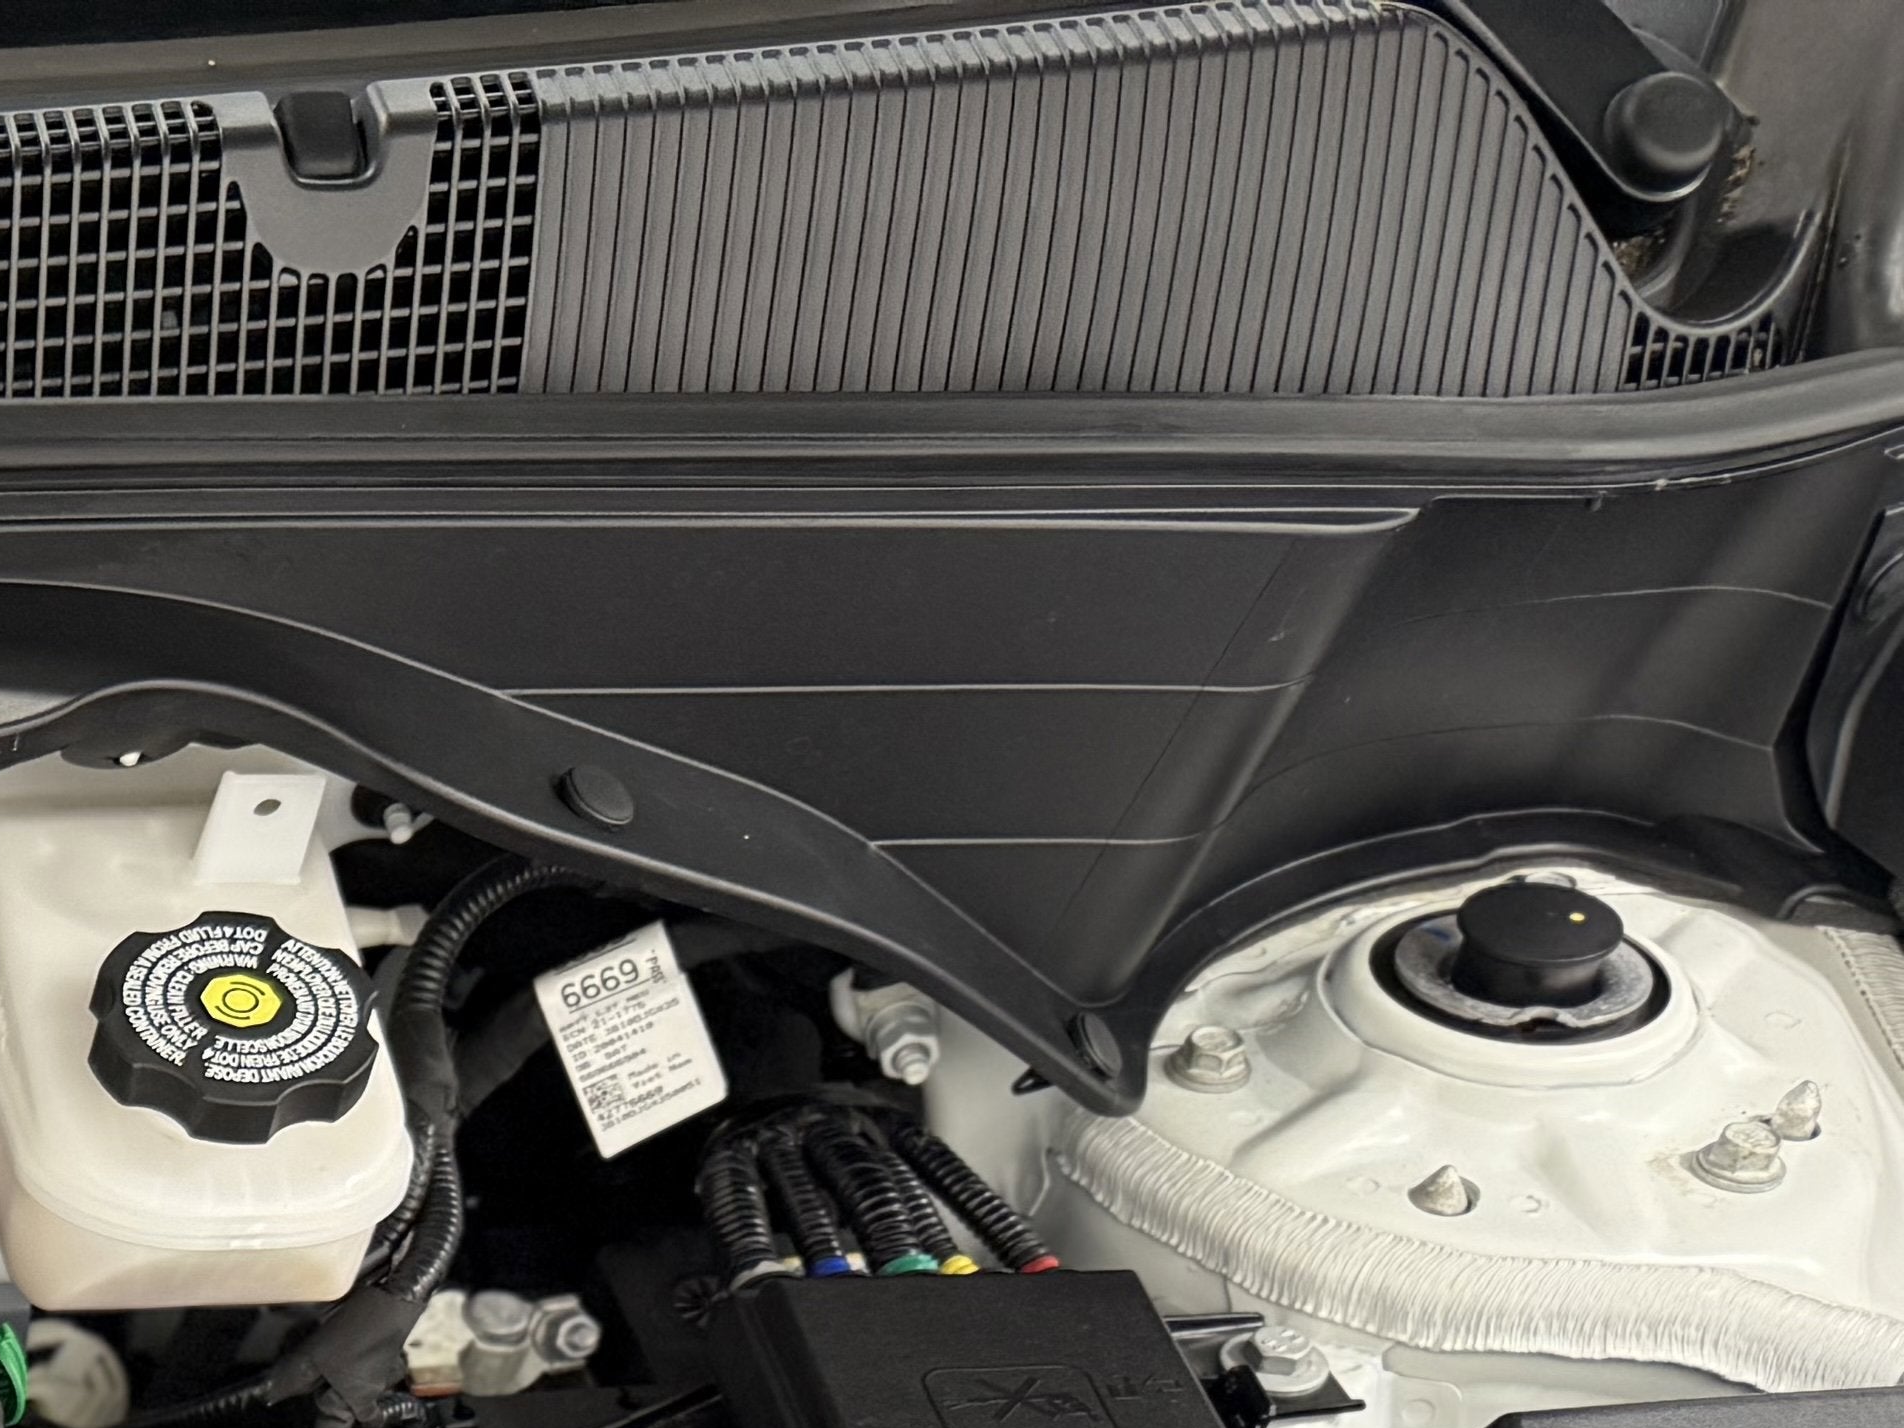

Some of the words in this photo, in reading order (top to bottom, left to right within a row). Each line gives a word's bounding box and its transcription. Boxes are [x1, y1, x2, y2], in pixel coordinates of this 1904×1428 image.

[179, 926, 222, 943] FLUID
[234, 926, 268, 942] DOT
[142, 935, 182, 963] FROM
[173, 939, 229, 962] BEFORE
[231, 940, 264, 955] CAP
[560, 958, 639, 1008] 6669
[161, 1025, 198, 1050] ONLY
[212, 1050, 240, 1067] DOT
[241, 1052, 281, 1067] FREIN
